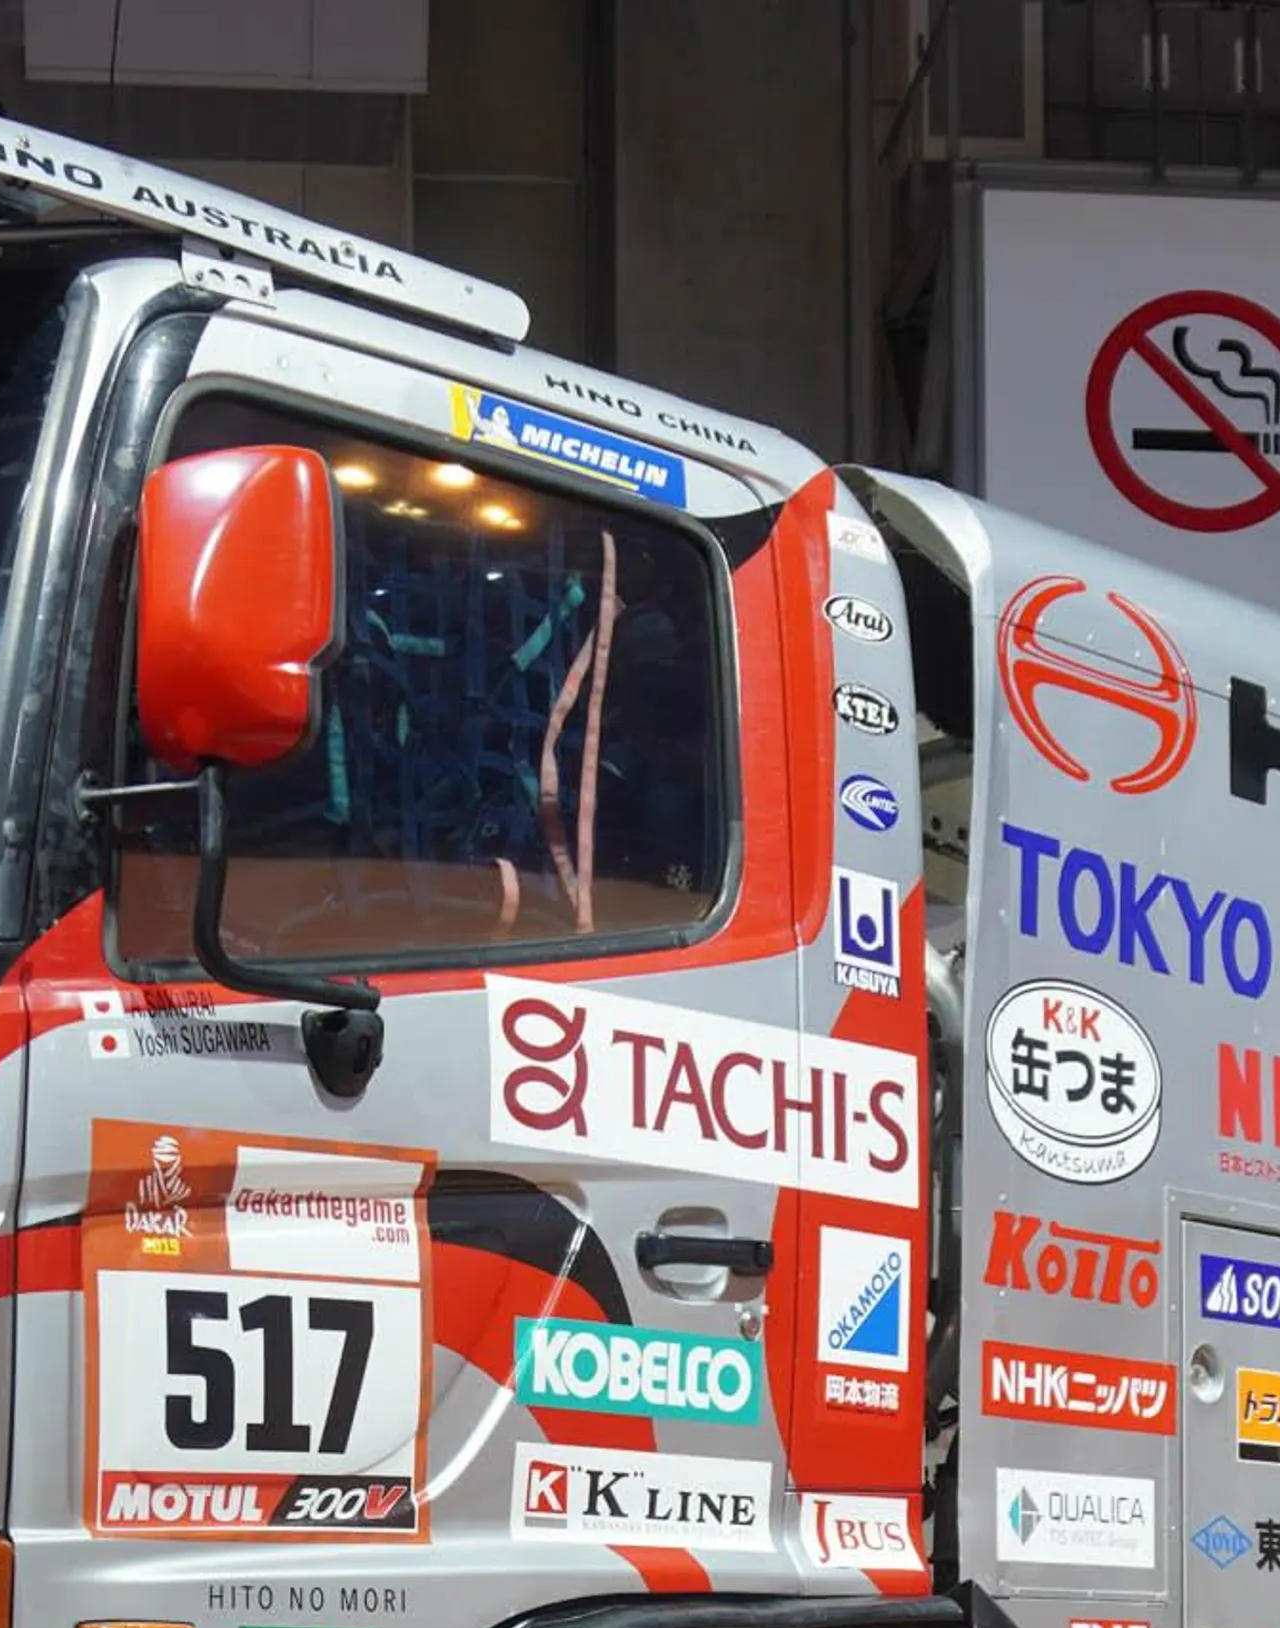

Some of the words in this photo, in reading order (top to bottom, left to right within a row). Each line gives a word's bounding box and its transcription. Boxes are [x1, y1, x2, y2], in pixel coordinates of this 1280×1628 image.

[132, 185, 404, 285] AUSTRALIA
[546, 374, 642, 417] HINO
[658, 412, 759, 456] CHINA
[521, 424, 668, 488] MICHELIN
[1002, 823, 1272, 1000] TOKYO
[836, 963, 899, 997] KASUYA
[133, 1026, 180, 1057] Yoshi
[181, 1021, 272, 1055] SUGAWARA
[1041, 998, 1101, 1043] K&K
[1010, 1028, 1138, 1115] 缶つま
[613, 1029, 909, 1173] TACHI-S
[124, 1201, 193, 1238] DAKAR
[234, 1187, 407, 1227] Dakarthegame
[370, 1225, 411, 1246] .com
[827, 1251, 903, 1351] OKAMOTO
[165, 1288, 374, 1455] 517
[531, 1327, 753, 1414] KOBELCO
[106, 1484, 263, 1523] MOTUL
[285, 1484, 407, 1522] 300V
[646, 1488, 756, 1528] LINE
[1048, 1490, 1146, 1527] QUALICA
[813, 1499, 833, 1565] J
[834, 1518, 907, 1553] BUS
[207, 1585, 274, 1611] HITO
[289, 1587, 325, 1612] NO
[339, 1588, 408, 1614] MORI
